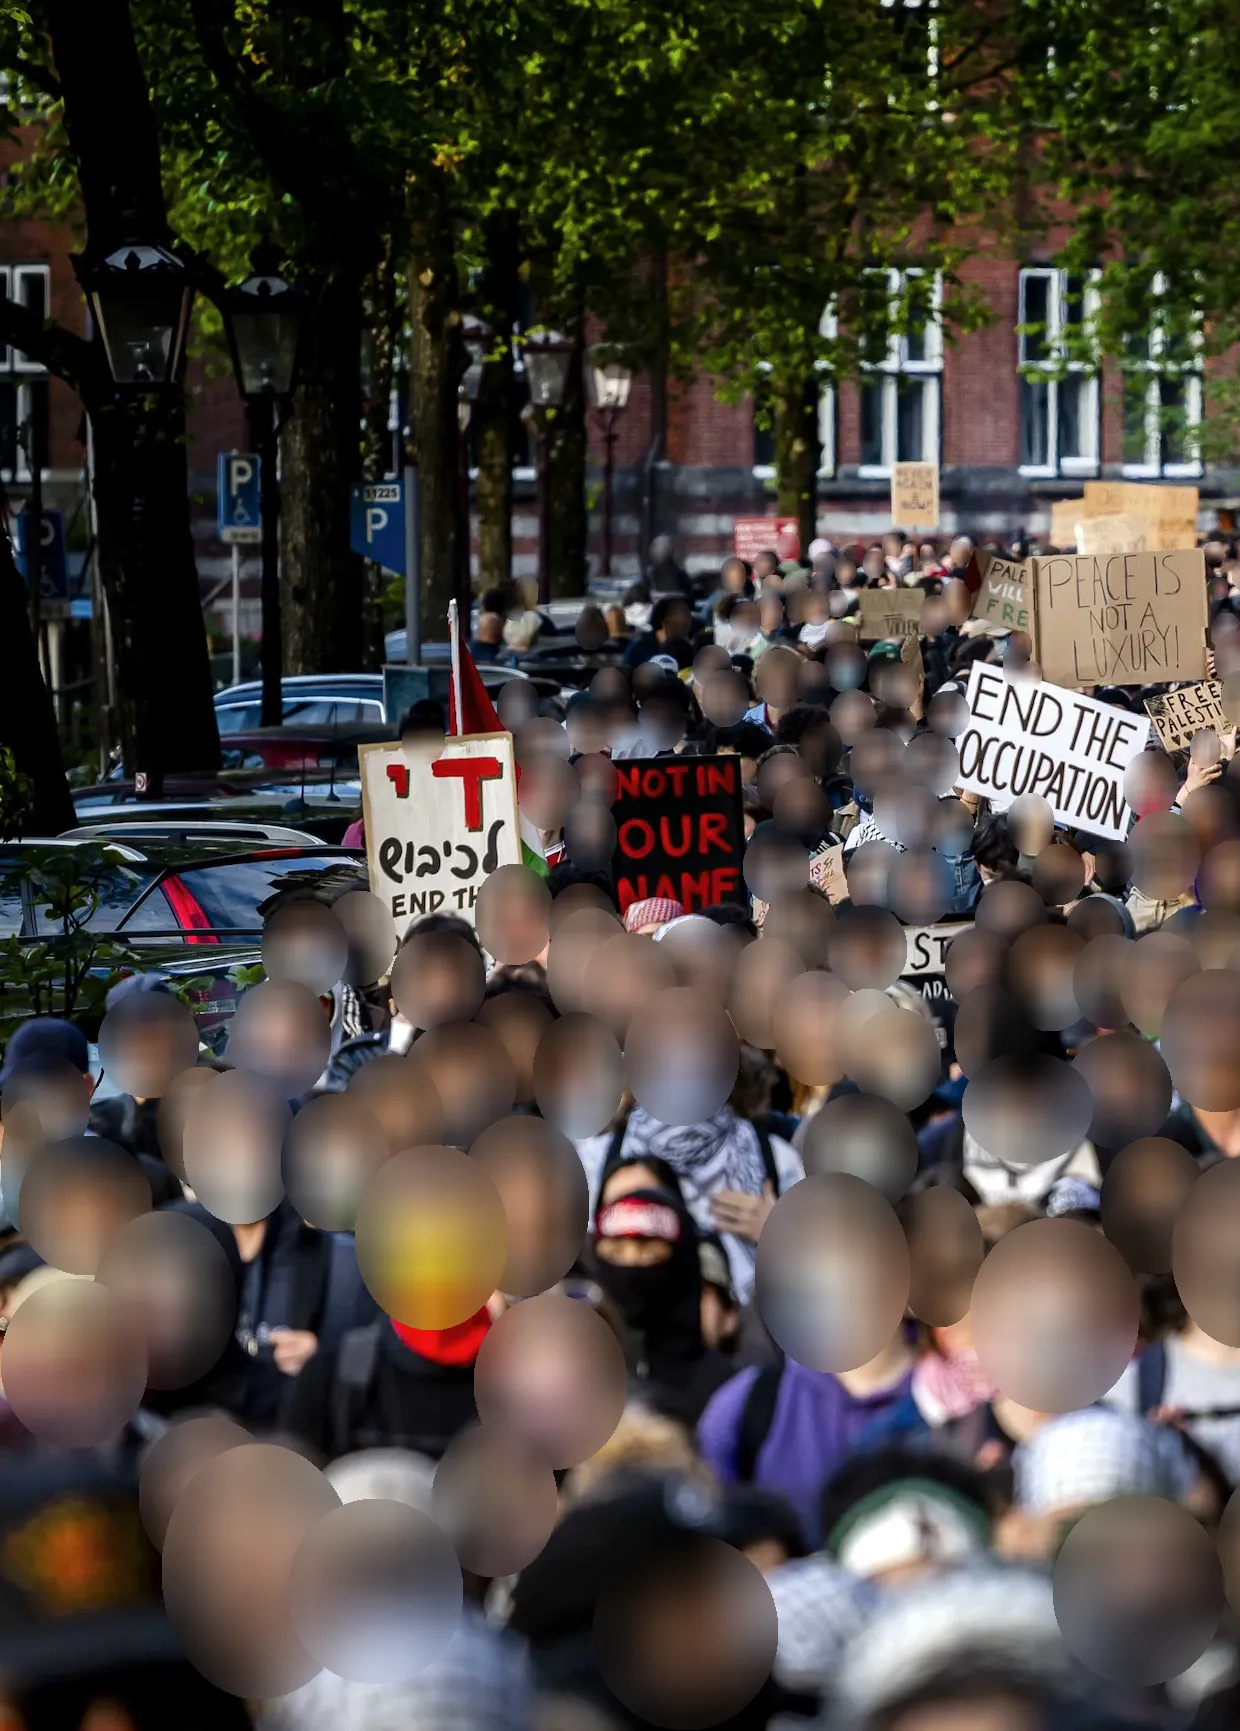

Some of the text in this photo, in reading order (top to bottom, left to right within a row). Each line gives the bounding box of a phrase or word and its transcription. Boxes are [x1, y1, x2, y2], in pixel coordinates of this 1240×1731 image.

[231, 459, 252, 497] P
[366, 508, 388, 543] P
[988, 580, 1024, 602] WILL
[990, 560, 1027, 585] PALE
[1041, 554, 1181, 610] PEACE IS
[986, 599, 1029, 627] FRE
[1090, 601, 1159, 635] NOT A
[1073, 624, 1180, 682] LUXURY!
[1166, 683, 1220, 714] FREE
[971, 672, 1138, 771] END THE
[1156, 701, 1222, 738] PALESTI
[617, 762, 735, 800] NOT IN
[959, 729, 1127, 830] OCCUPATION
[379, 819, 505, 884] לכיבוש
[618, 812, 733, 860] OUR
[392, 885, 482, 918] END TH
[910, 931, 954, 970] ST
